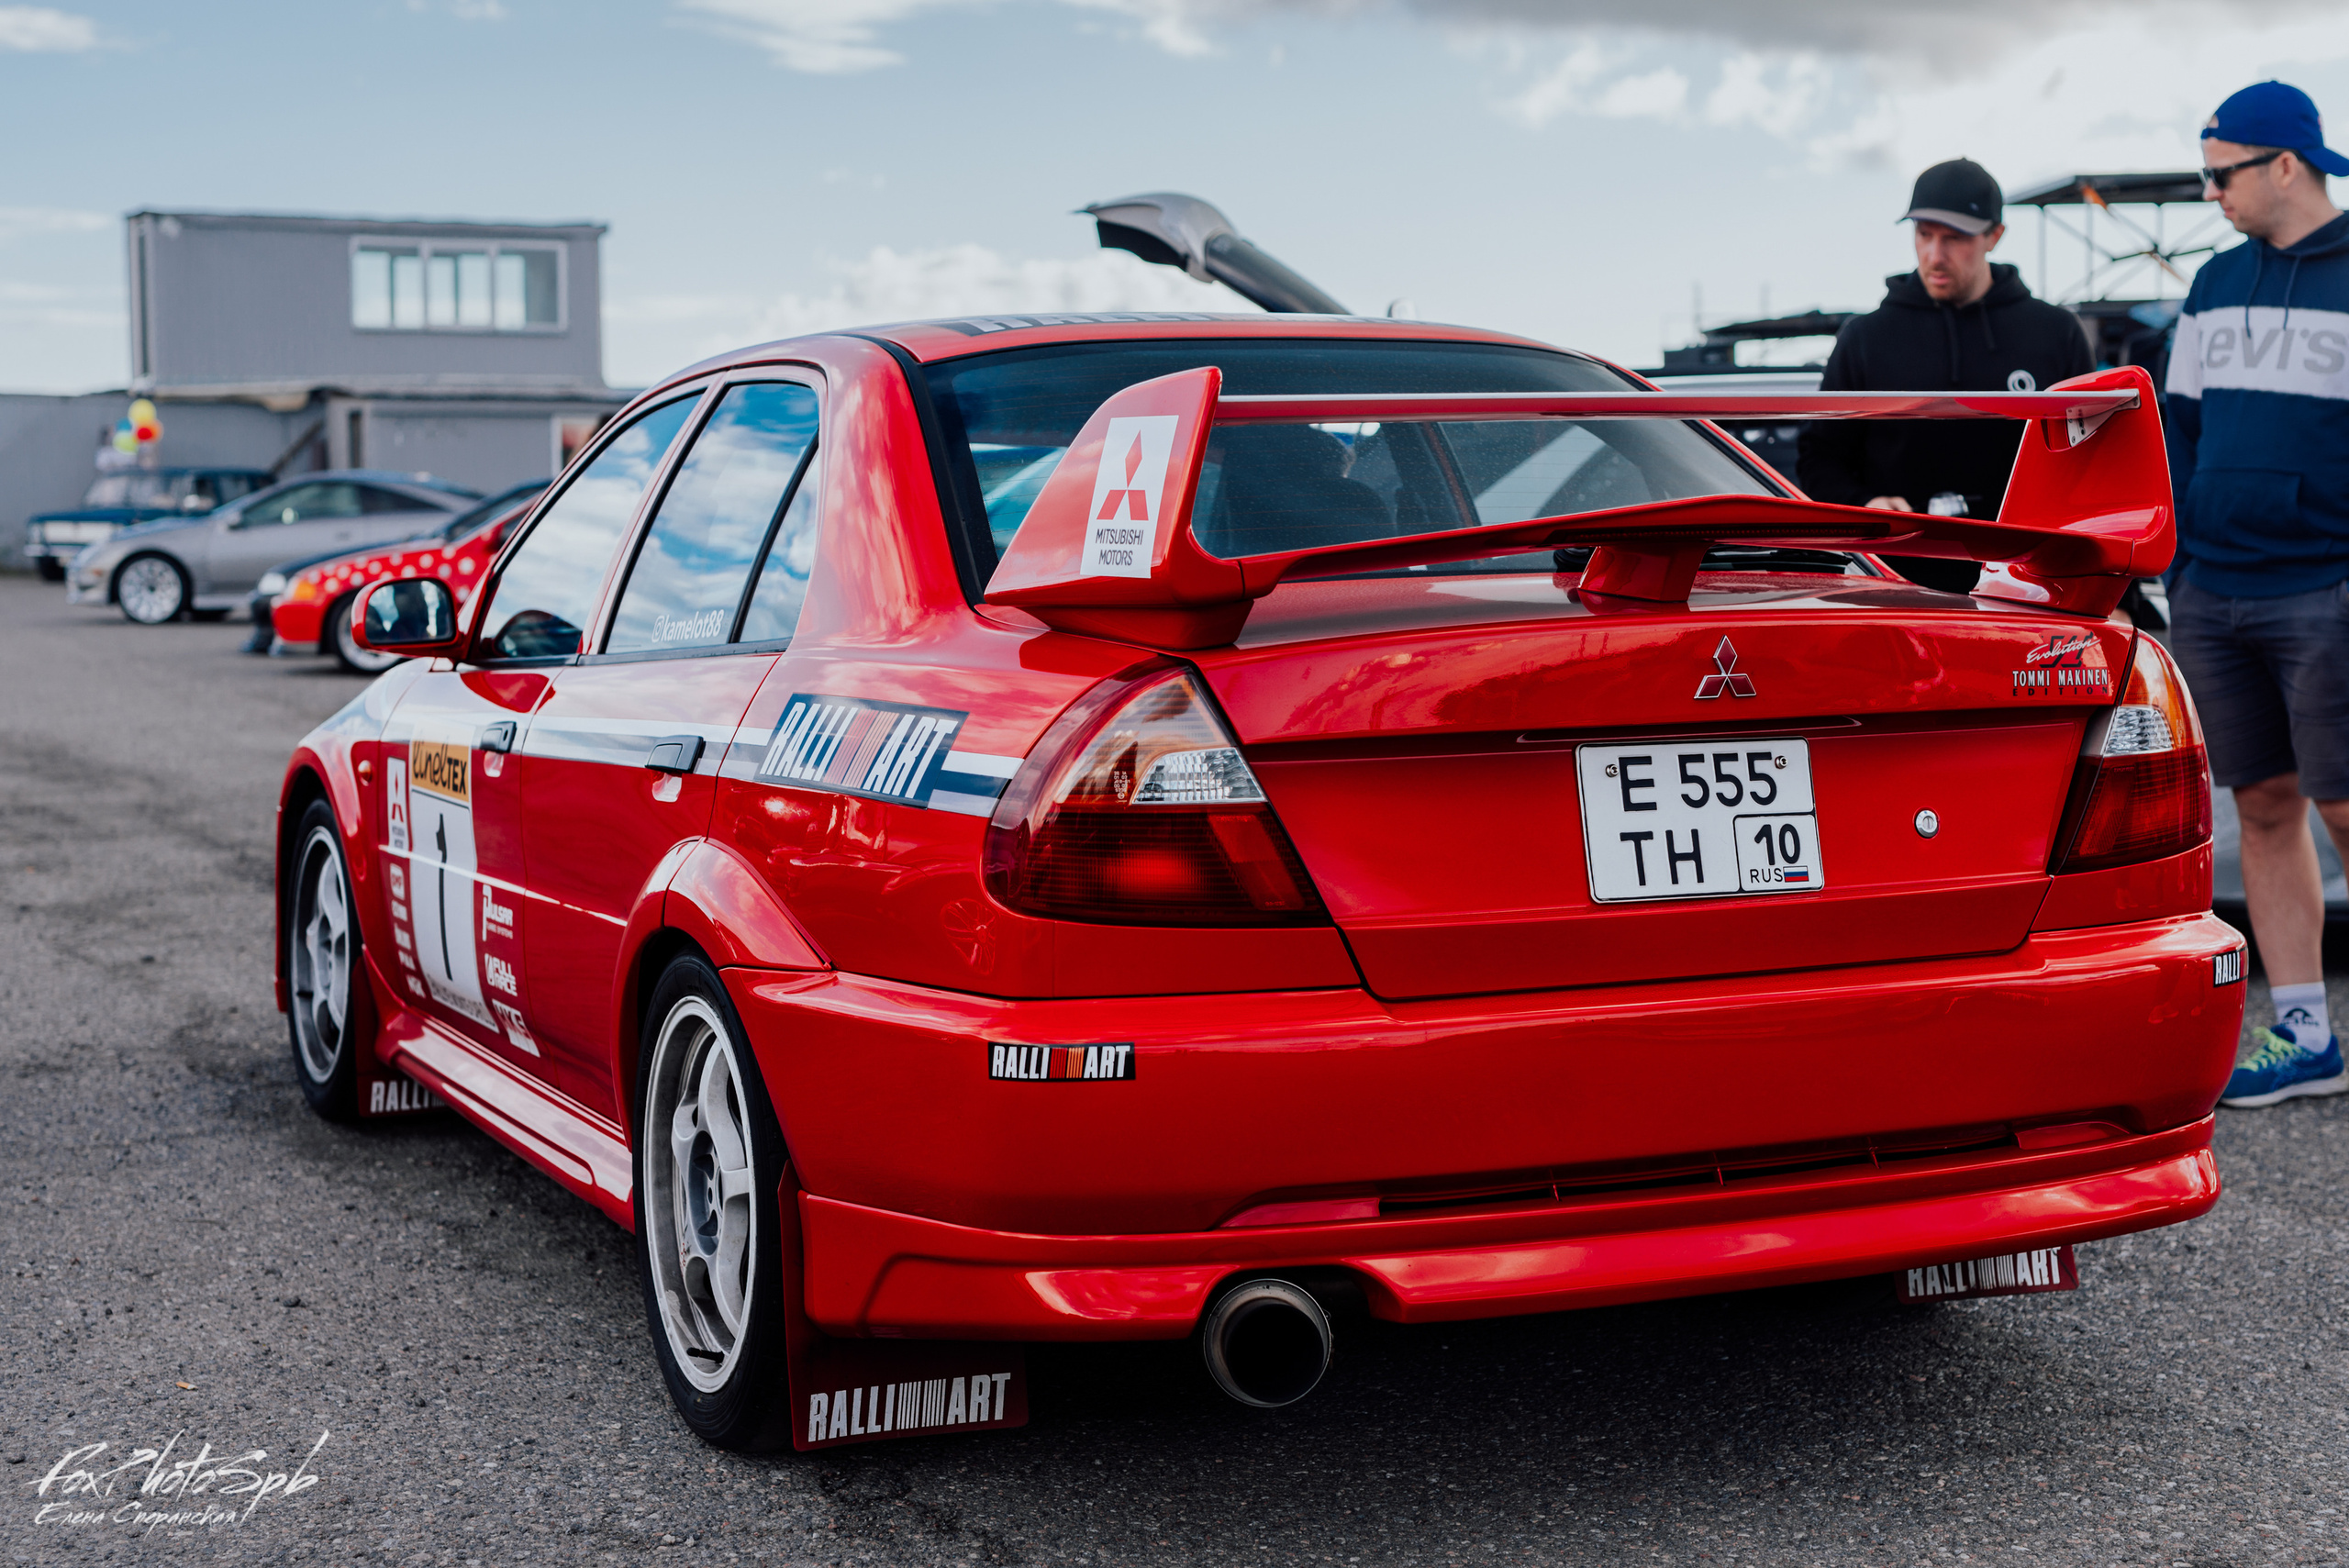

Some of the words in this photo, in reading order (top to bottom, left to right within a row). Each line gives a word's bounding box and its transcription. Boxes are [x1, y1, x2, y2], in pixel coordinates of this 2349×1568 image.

[2199, 326, 2346, 374] evi's
[1096, 528, 1144, 545] MITSUBISHI
[1098, 550, 1133, 565] MOTORS
[2026, 639, 2101, 663] Evolution
[2012, 670, 2051, 687] TOMMI
[2058, 669, 2108, 686] MAKINEN
[2012, 687, 2108, 696] EDITION
[1618, 755, 1657, 812] E
[1677, 751, 1777, 808] 555
[1754, 823, 1800, 865] 10
[1620, 828, 1704, 886] TH
[1750, 868, 1783, 884] RUS
[436, 813, 453, 982] 1
